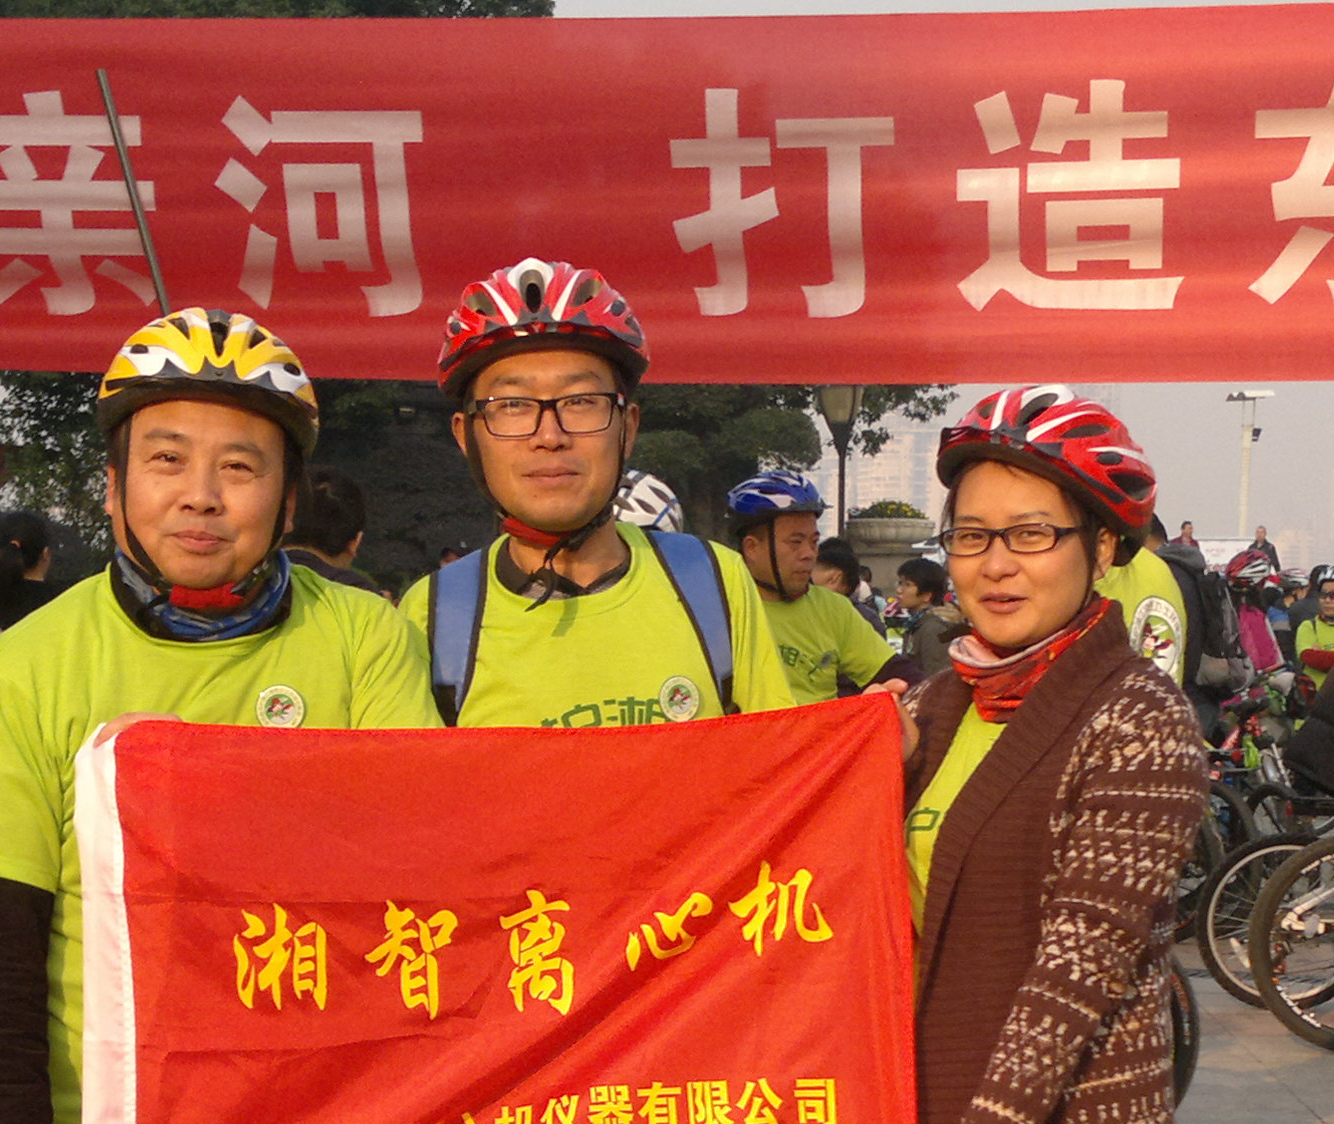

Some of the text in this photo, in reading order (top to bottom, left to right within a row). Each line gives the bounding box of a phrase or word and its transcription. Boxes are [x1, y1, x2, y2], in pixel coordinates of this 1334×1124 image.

[232, 861, 834, 1019] 湘智离心机
